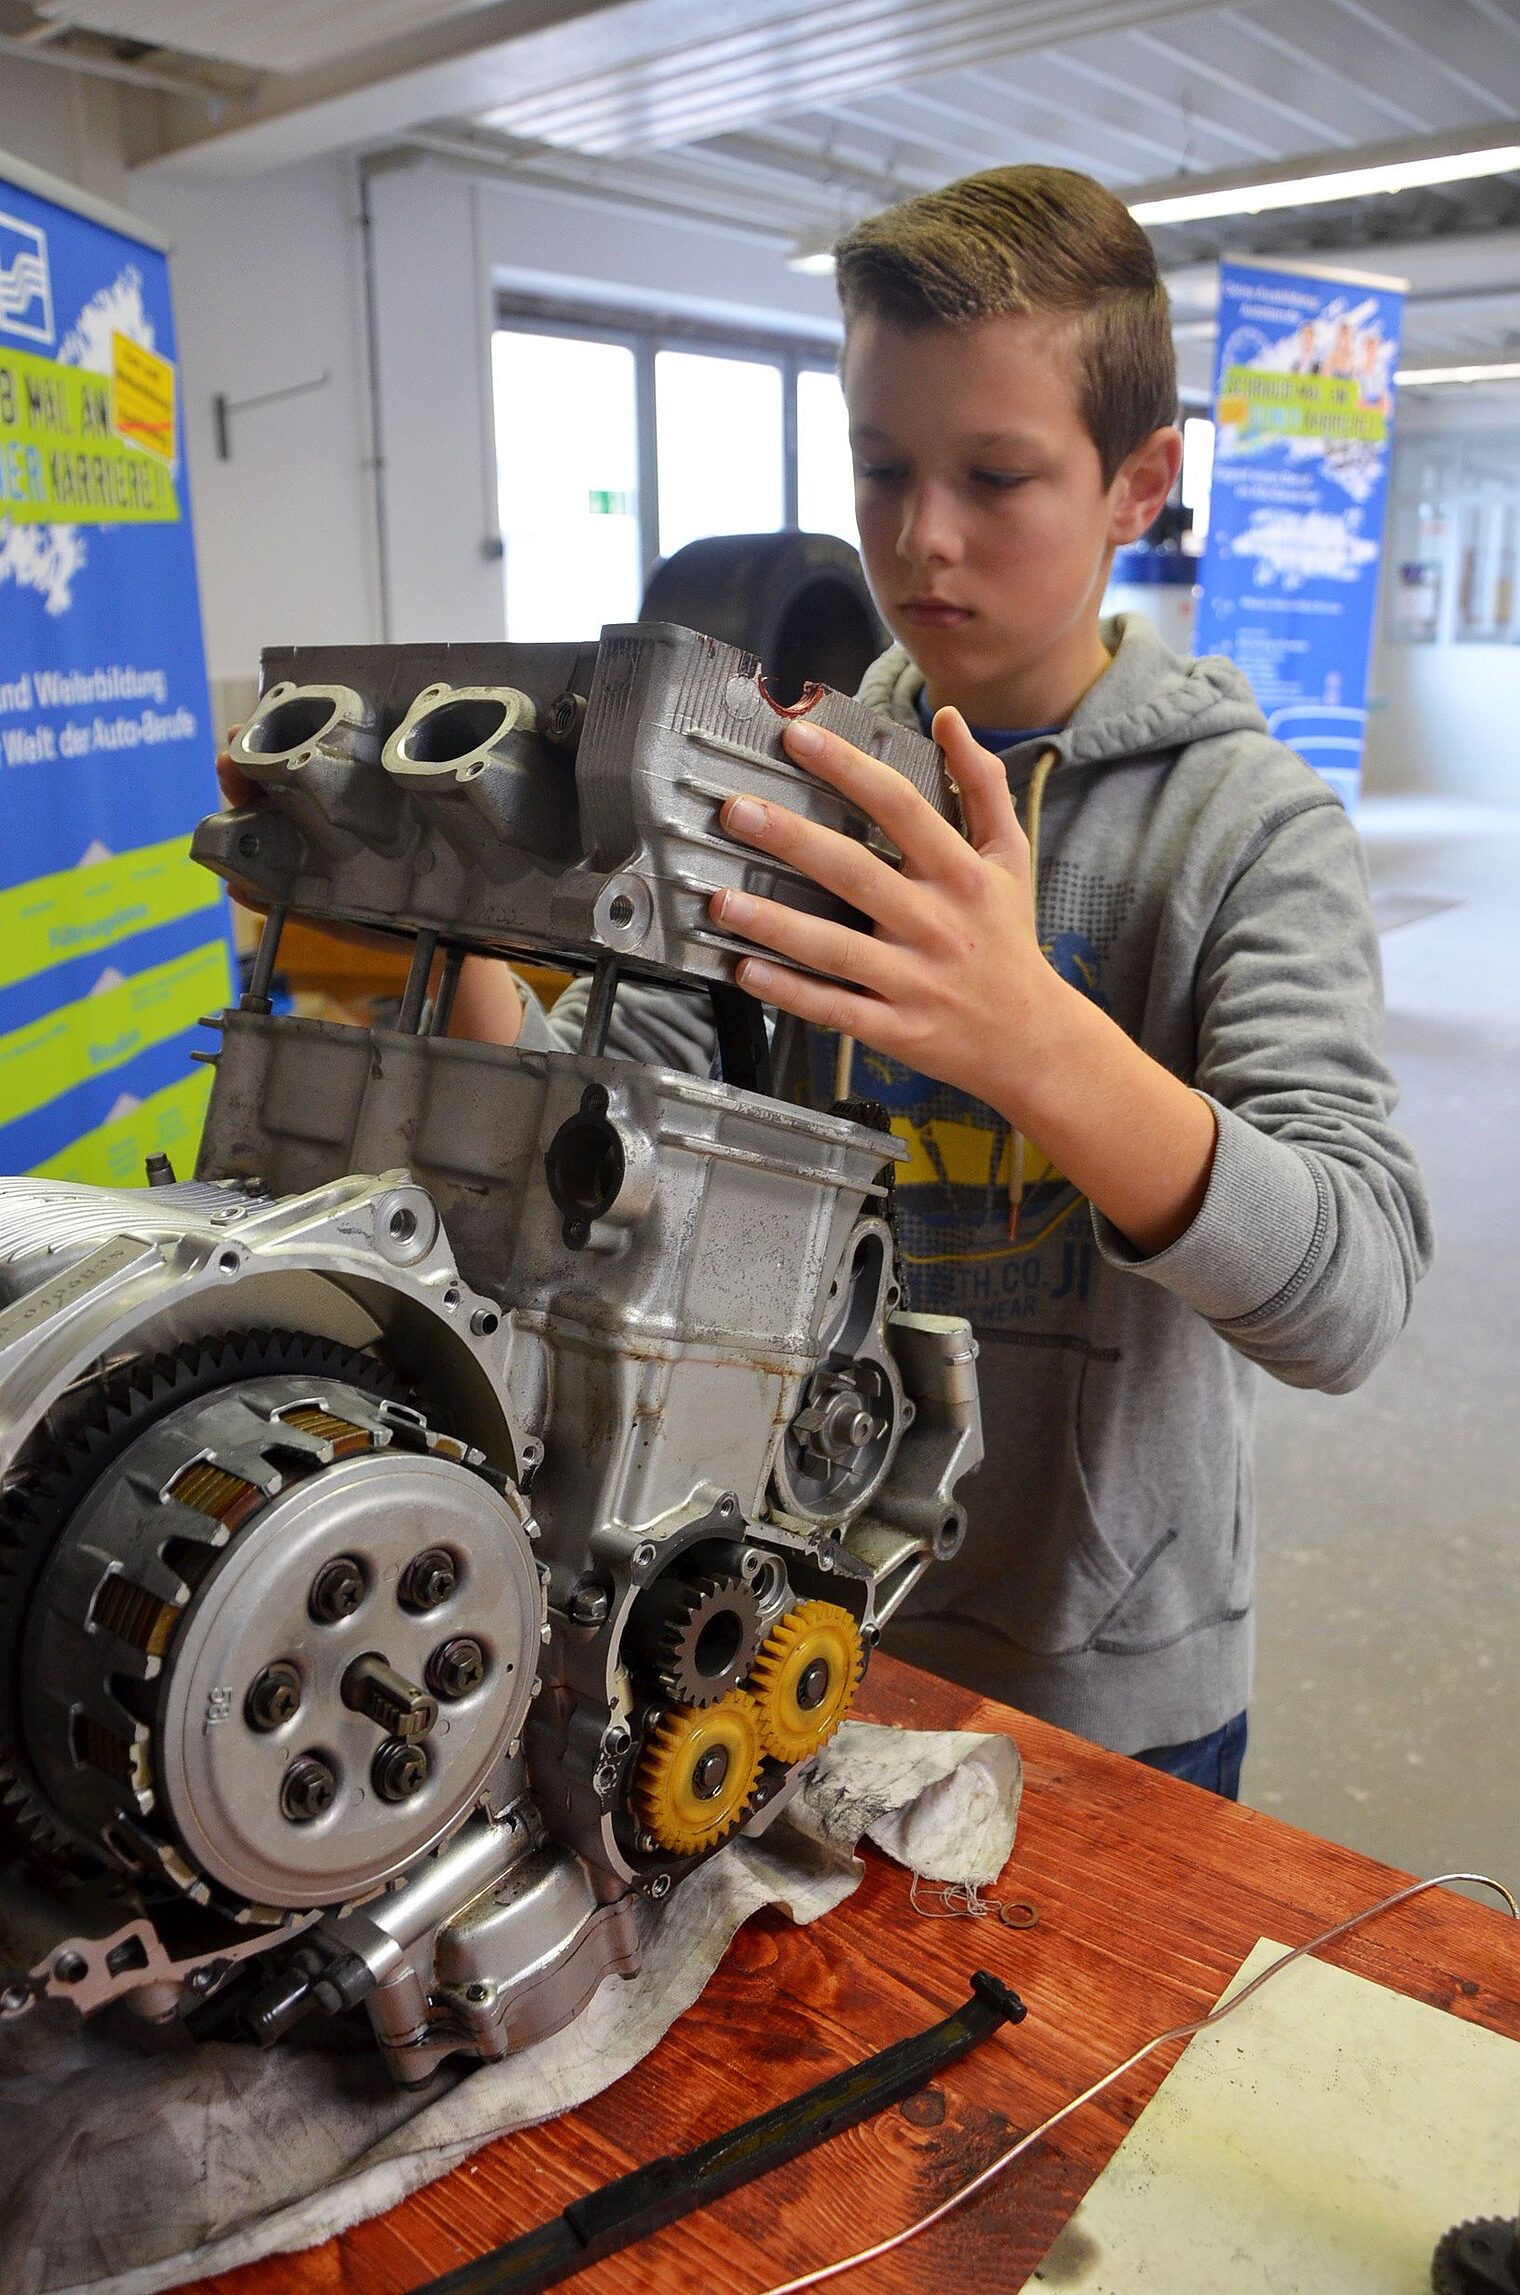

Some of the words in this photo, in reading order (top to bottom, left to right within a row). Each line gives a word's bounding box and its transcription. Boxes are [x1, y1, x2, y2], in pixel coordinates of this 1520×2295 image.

[24, 372, 73, 436] MAL
[0, 440, 46, 502] ER
[50, 448, 168, 512] KARRIERE!
[33, 665, 167, 707] Weiterbildung
[2, 723, 57, 767] Welt
[92, 705, 197, 752] Auto-Berufe
